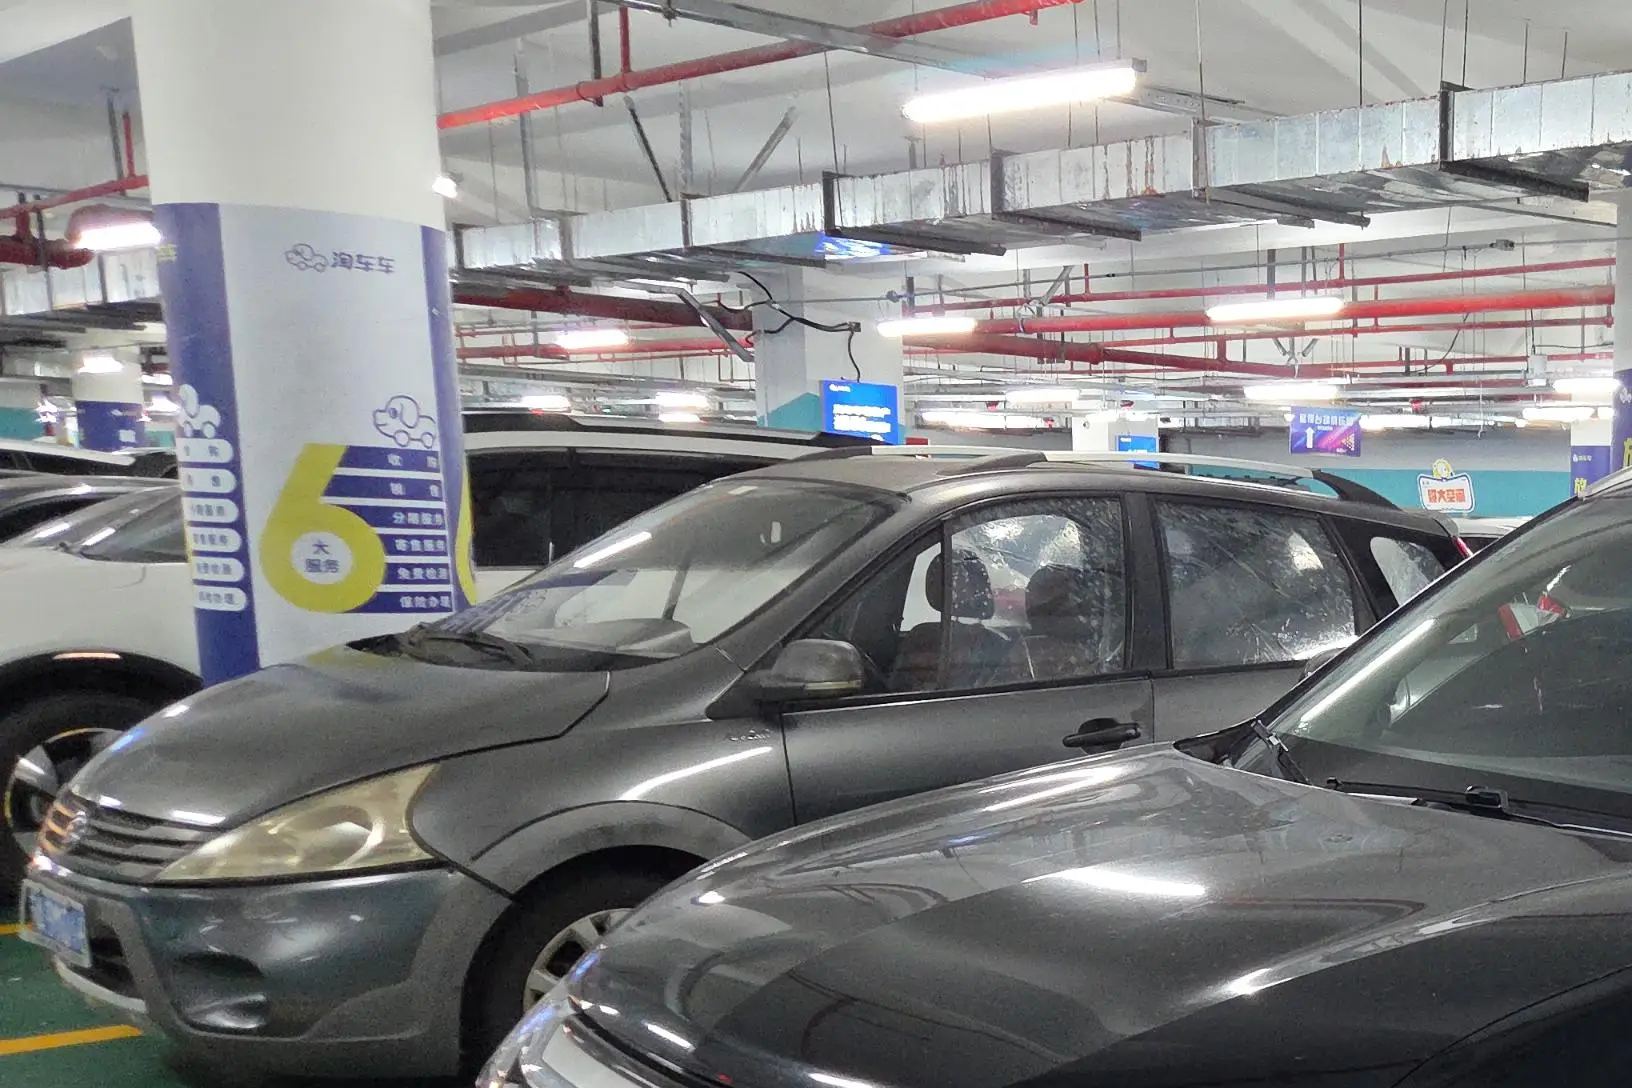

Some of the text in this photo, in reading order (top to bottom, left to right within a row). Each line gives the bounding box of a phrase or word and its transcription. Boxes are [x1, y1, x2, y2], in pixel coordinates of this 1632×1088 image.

[331, 251, 396, 274] 淘车车
[311, 539, 330, 556] 大
[305, 558, 341, 574] 服务
